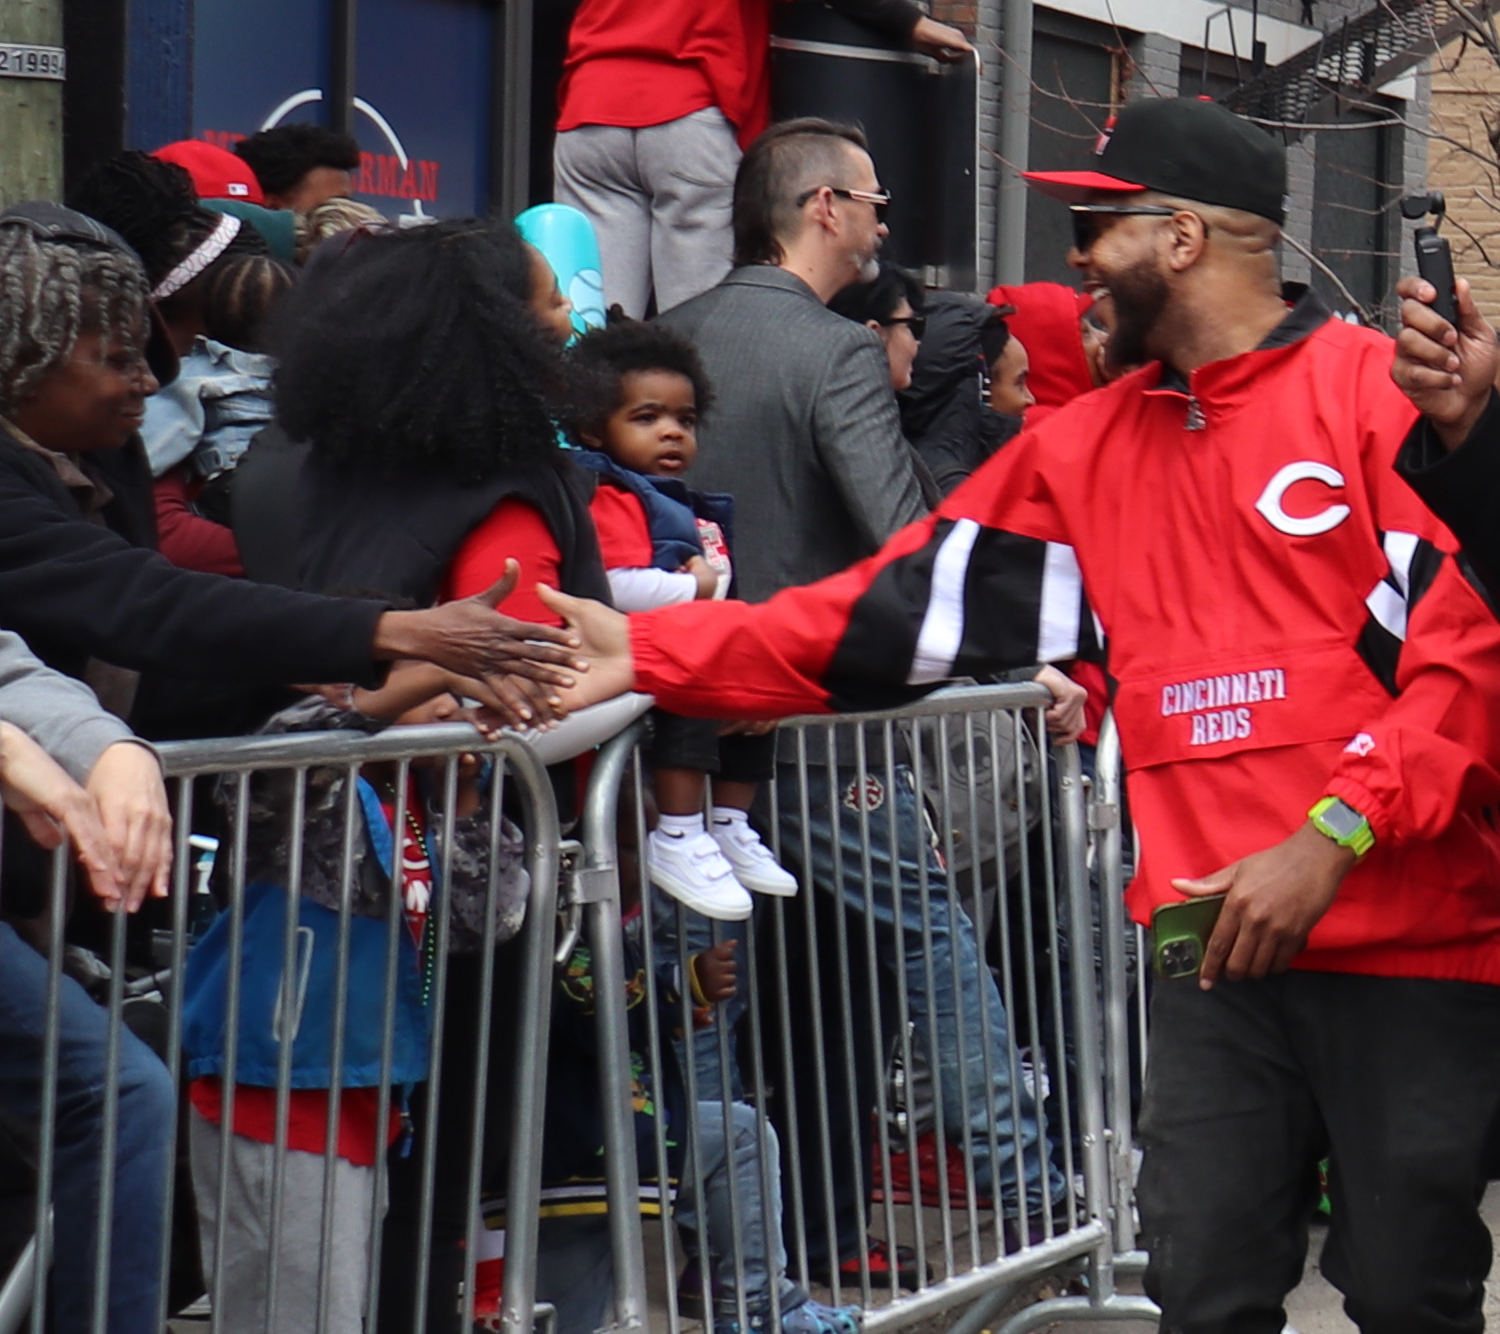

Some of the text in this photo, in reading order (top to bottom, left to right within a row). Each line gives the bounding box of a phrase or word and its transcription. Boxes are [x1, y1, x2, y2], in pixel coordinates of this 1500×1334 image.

[1254, 460, 1352, 536] C
[1161, 668, 1286, 716] CINCINNATI
[1190, 708, 1251, 746] REDS
